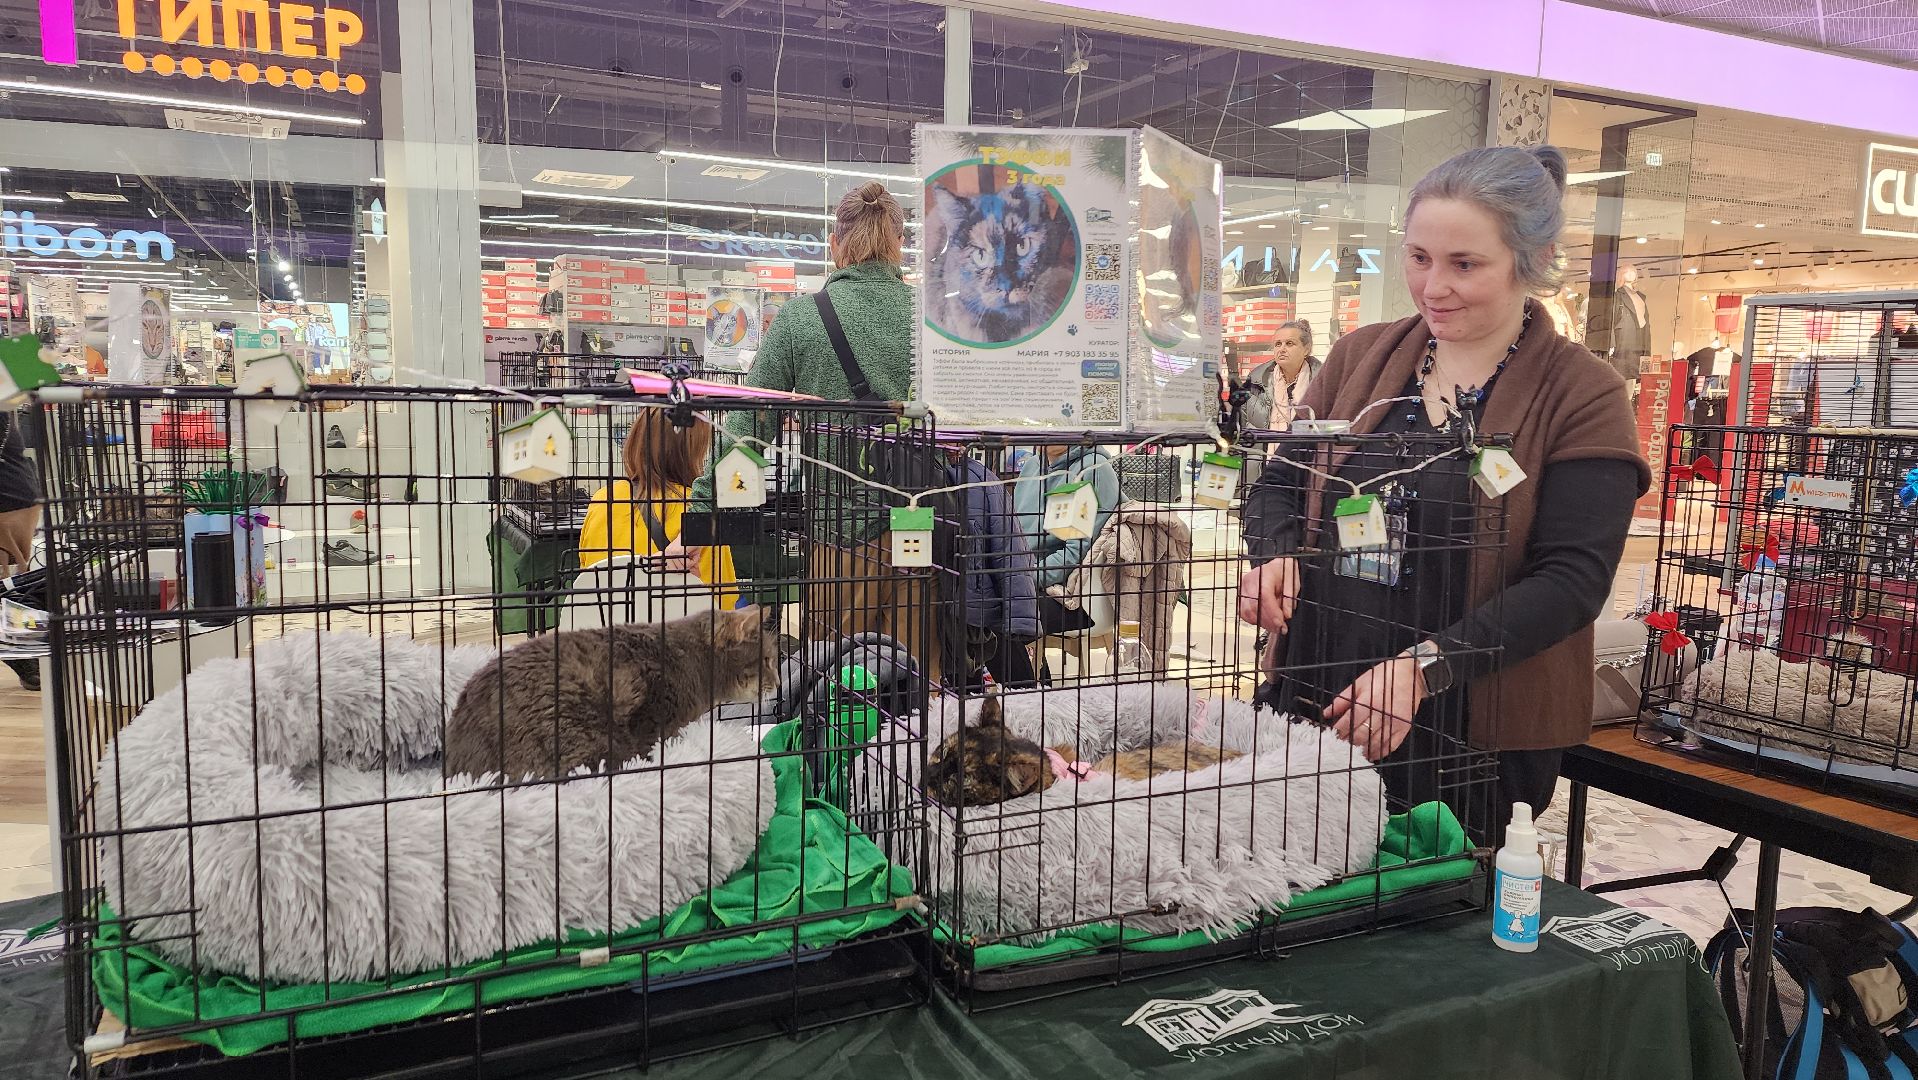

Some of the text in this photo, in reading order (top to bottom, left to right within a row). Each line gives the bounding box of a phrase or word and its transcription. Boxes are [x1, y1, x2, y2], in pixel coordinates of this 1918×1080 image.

[978, 146, 1071, 167] ТЭФФИ
[1006, 170, 1066, 186] 3 года
[1872, 168, 1918, 218] CU
[932, 348, 970, 356] ИСТОРИЯ
[1053, 350, 1064, 358] +7
[1065, 350, 1081, 358] 903
[1806, 488, 1848, 500] WILD-TOWN
[1173, 1012, 1365, 1063] УЮТНЫЙ ДОМ
